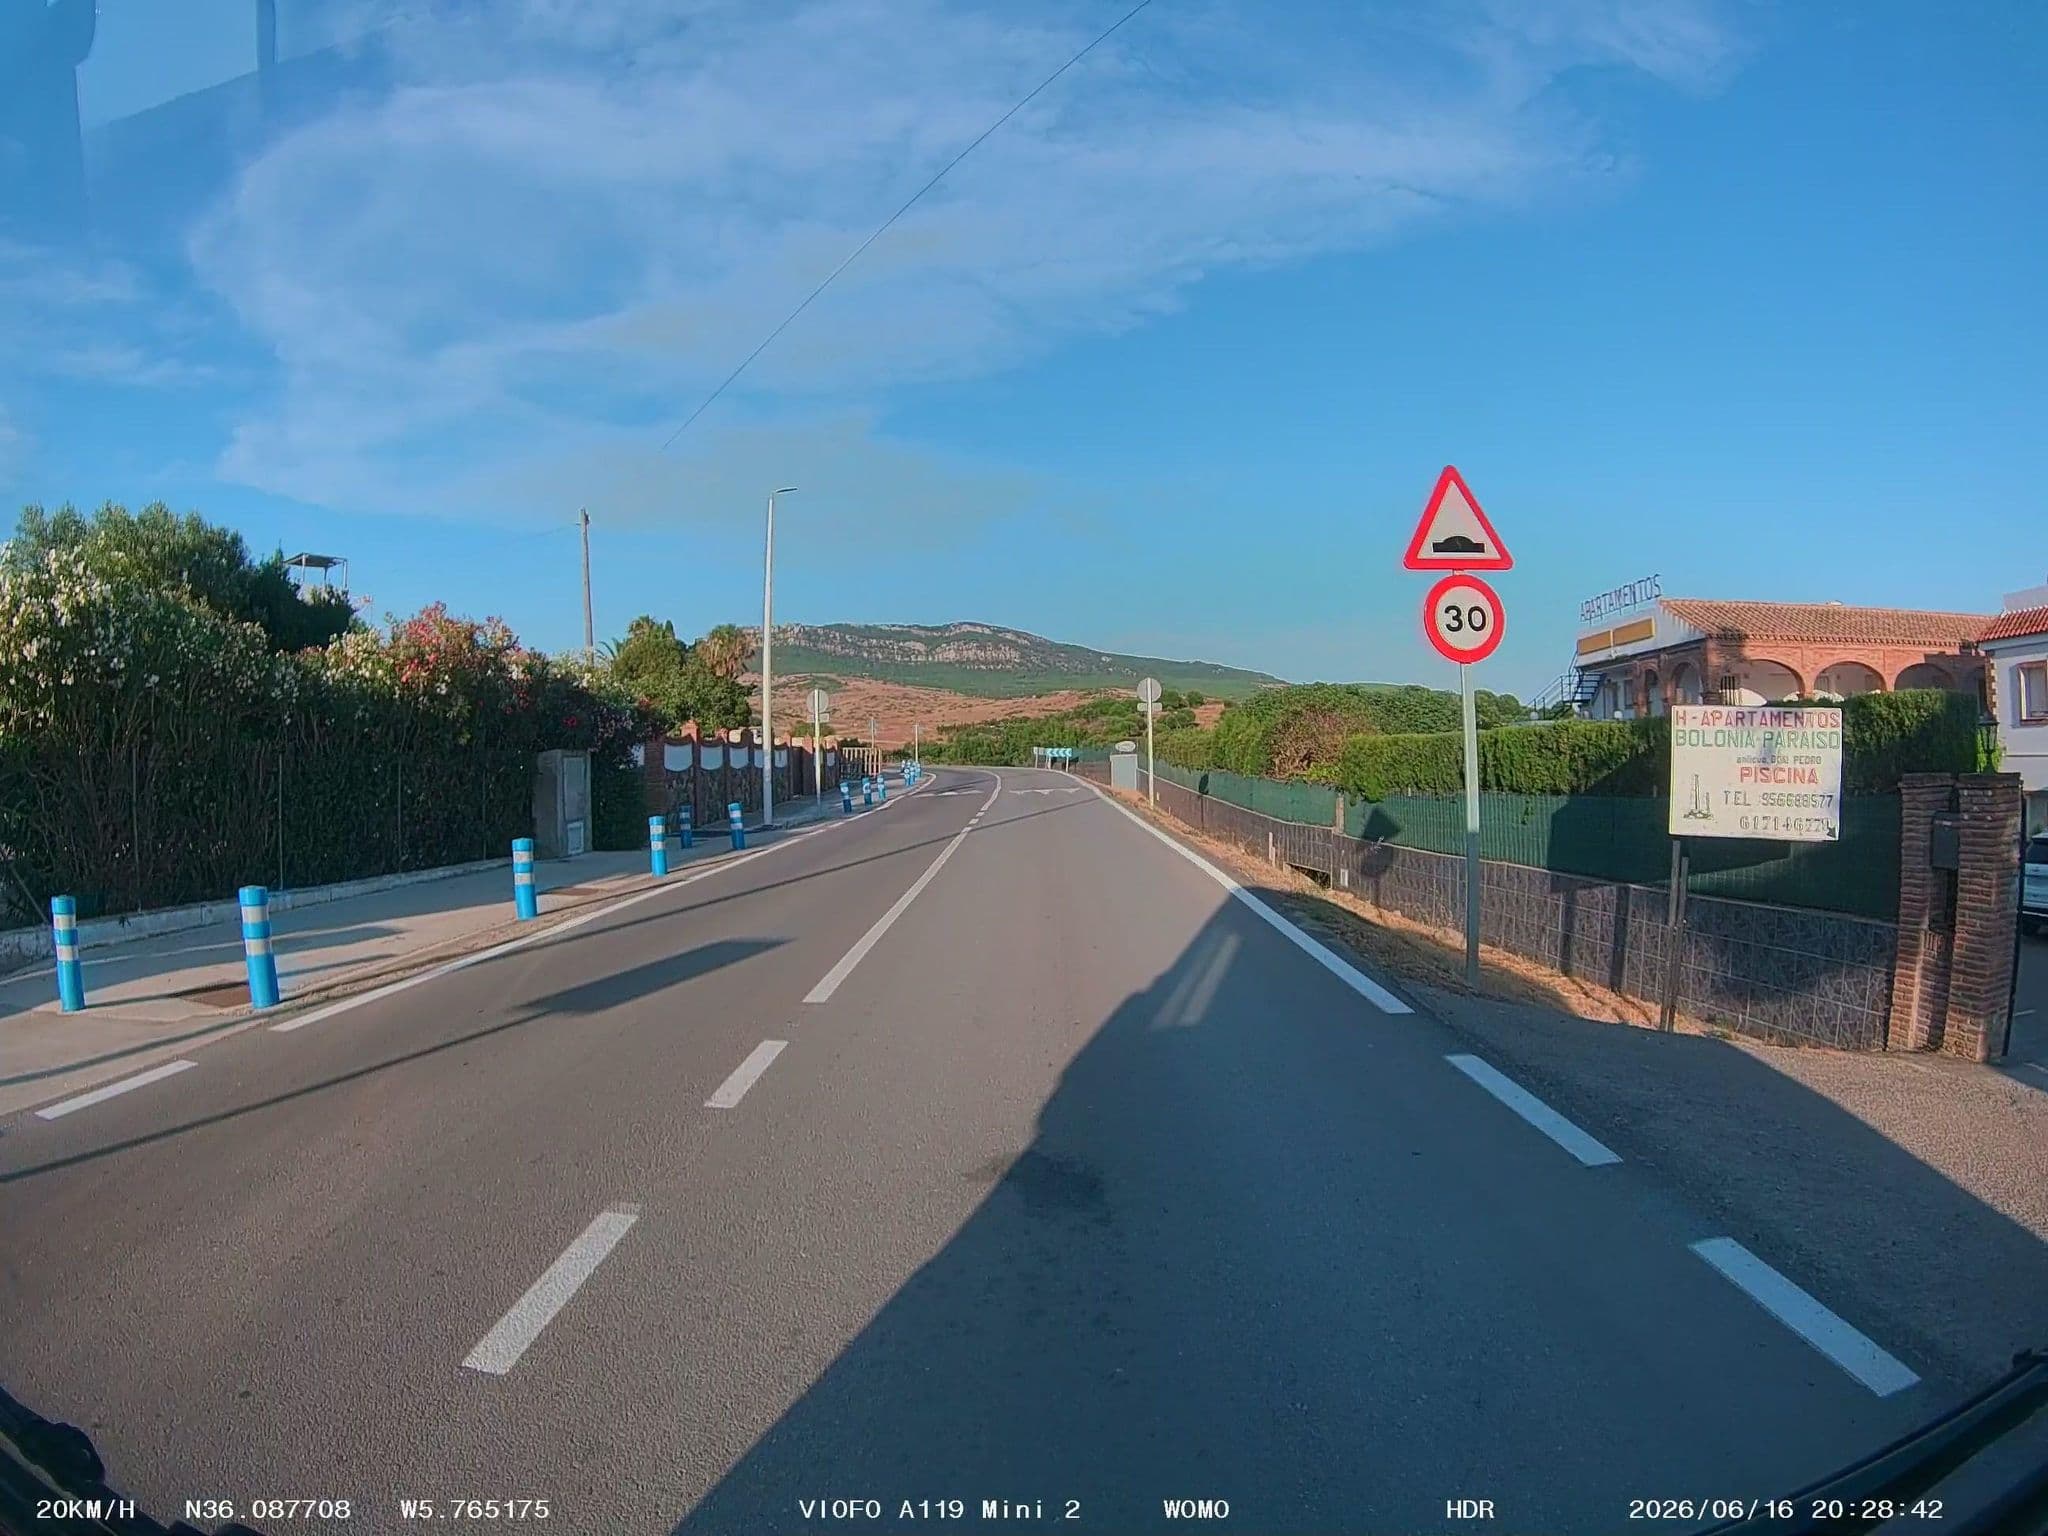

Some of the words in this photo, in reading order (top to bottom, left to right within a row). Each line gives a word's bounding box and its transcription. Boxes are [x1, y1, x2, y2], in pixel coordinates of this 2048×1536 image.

[1580, 573, 1661, 621] APARTAMENTOS
[1444, 605, 1487, 632] 30
[1675, 729, 1755, 748] BOLONIA
[1763, 730, 1840, 749] PARAISO
[1794, 755, 1822, 765] PEDRO
[1740, 766, 1818, 784] PISCINA
